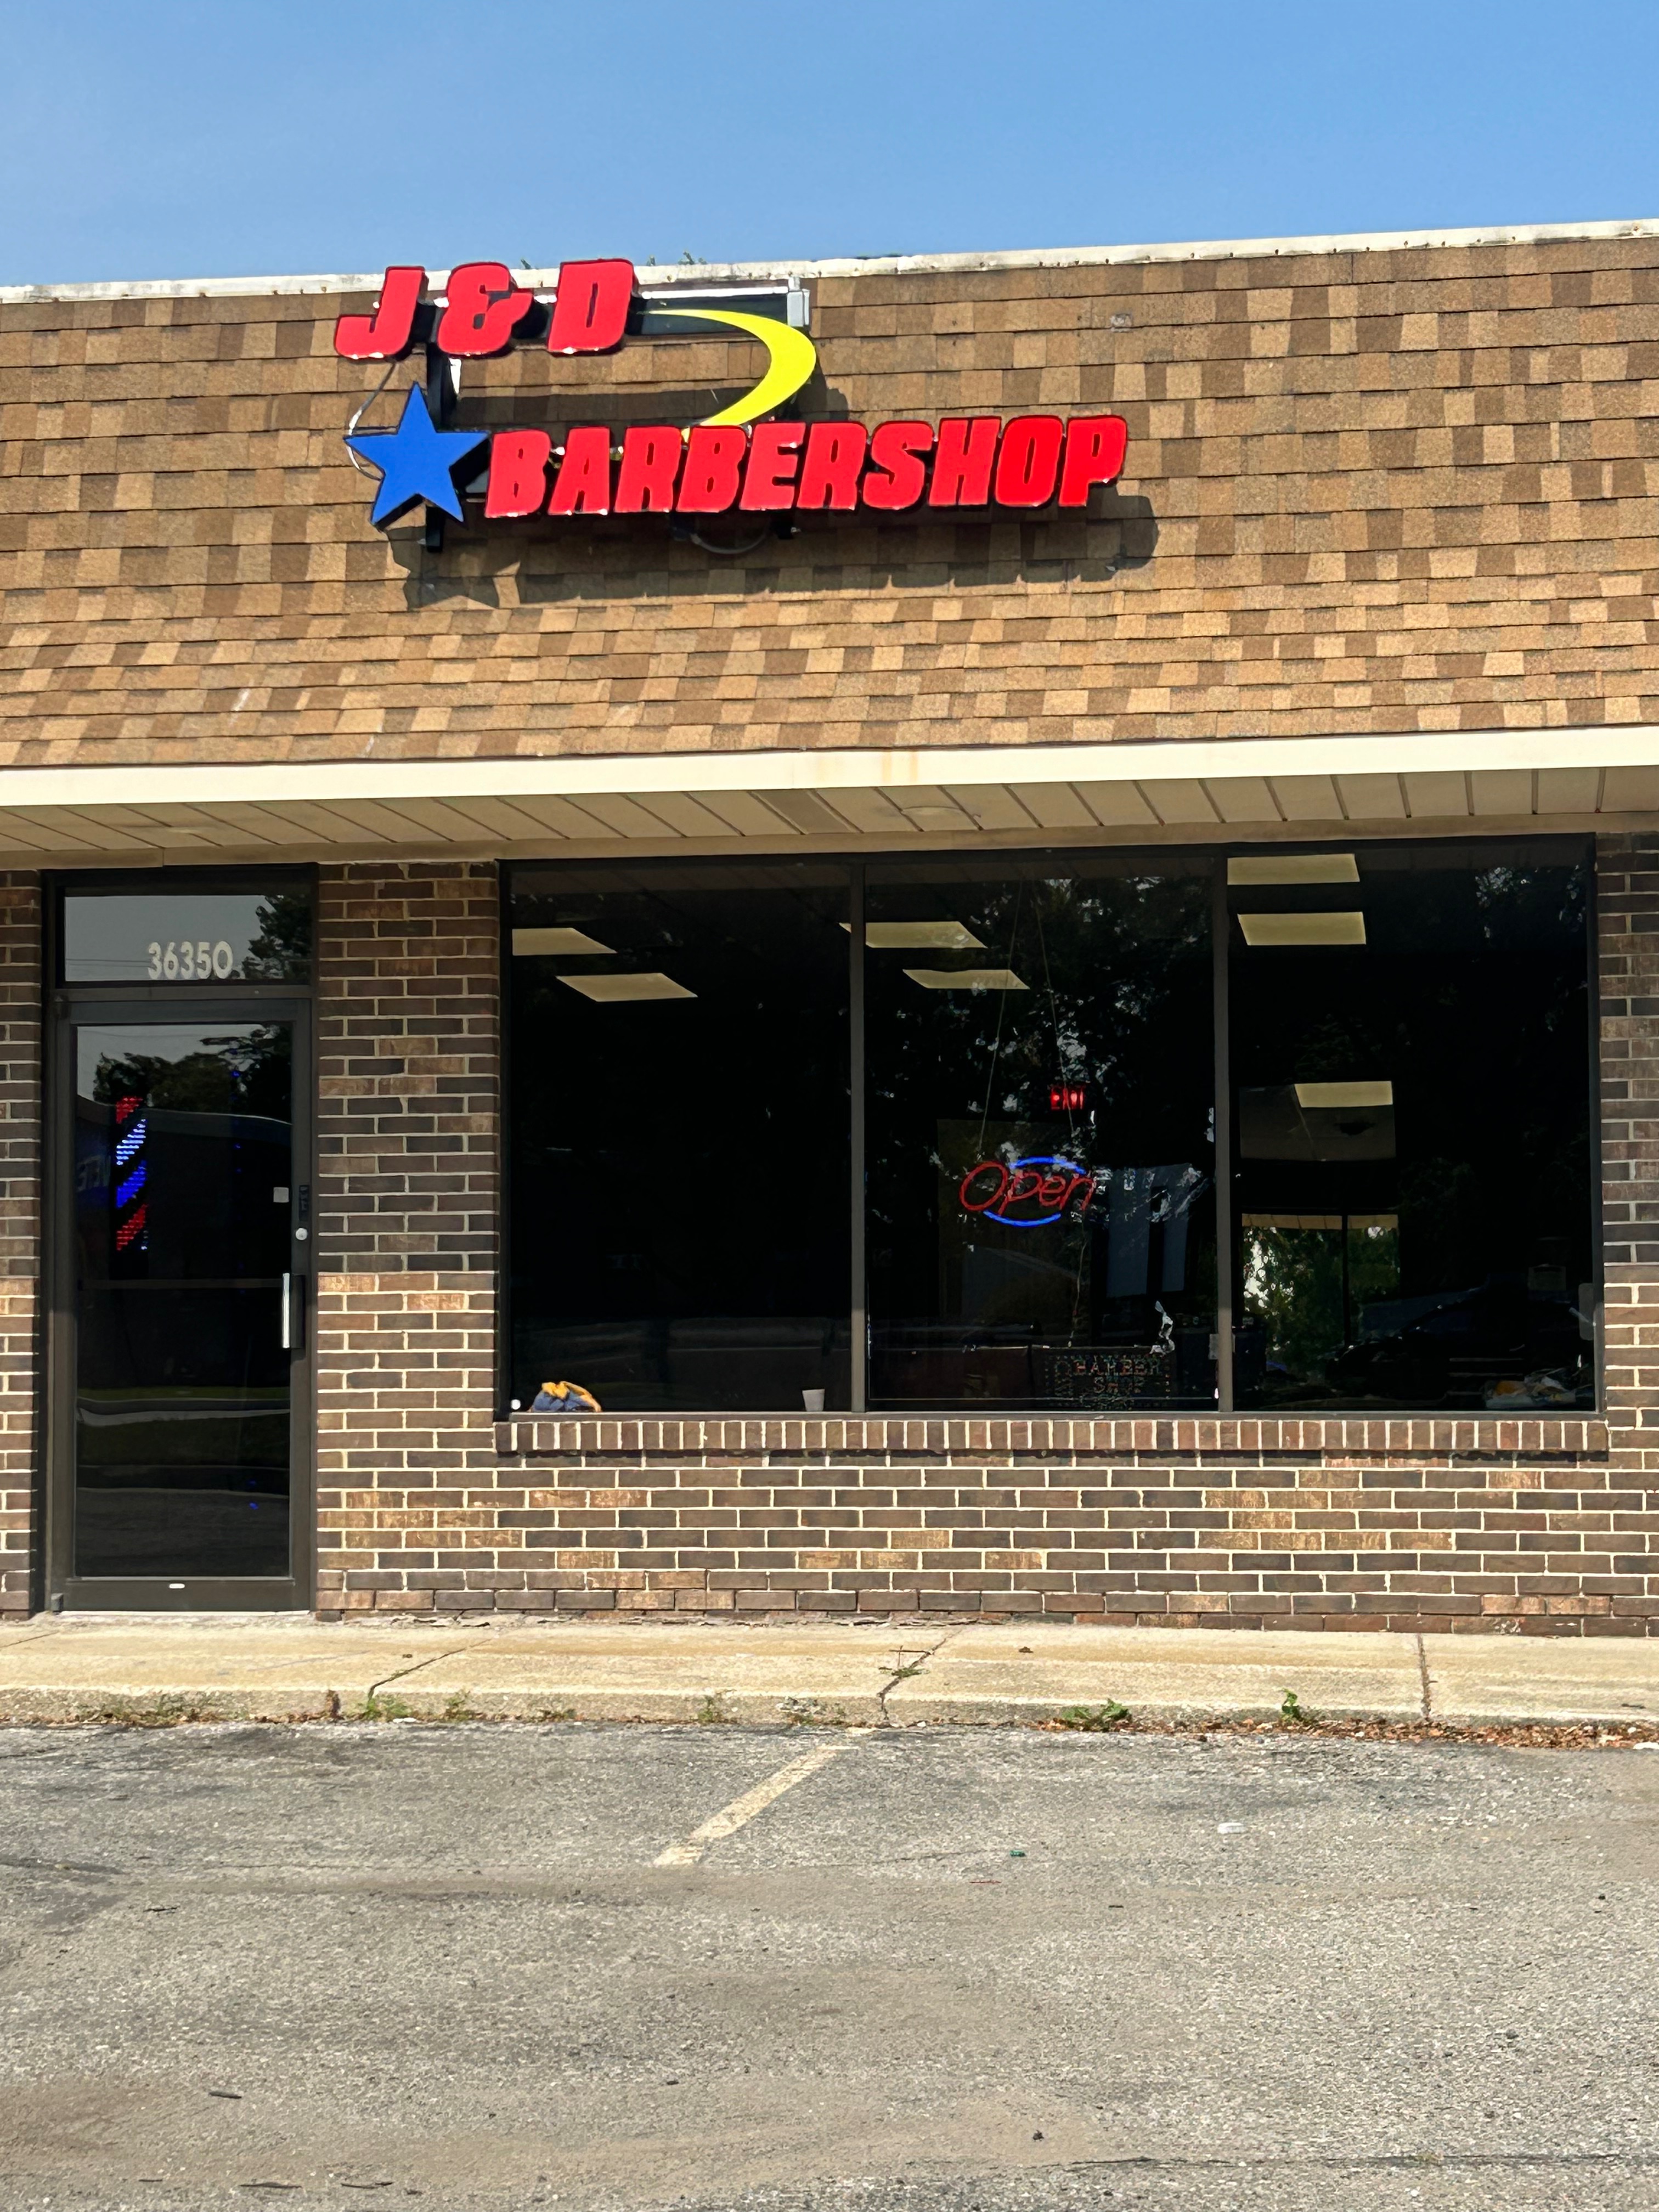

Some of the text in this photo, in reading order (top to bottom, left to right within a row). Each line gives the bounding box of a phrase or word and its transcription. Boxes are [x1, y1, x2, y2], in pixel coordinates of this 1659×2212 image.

[335, 258, 635, 359] J & D
[484, 414, 1127, 518] BARBERSHOP
[148, 940, 234, 980] 36350
